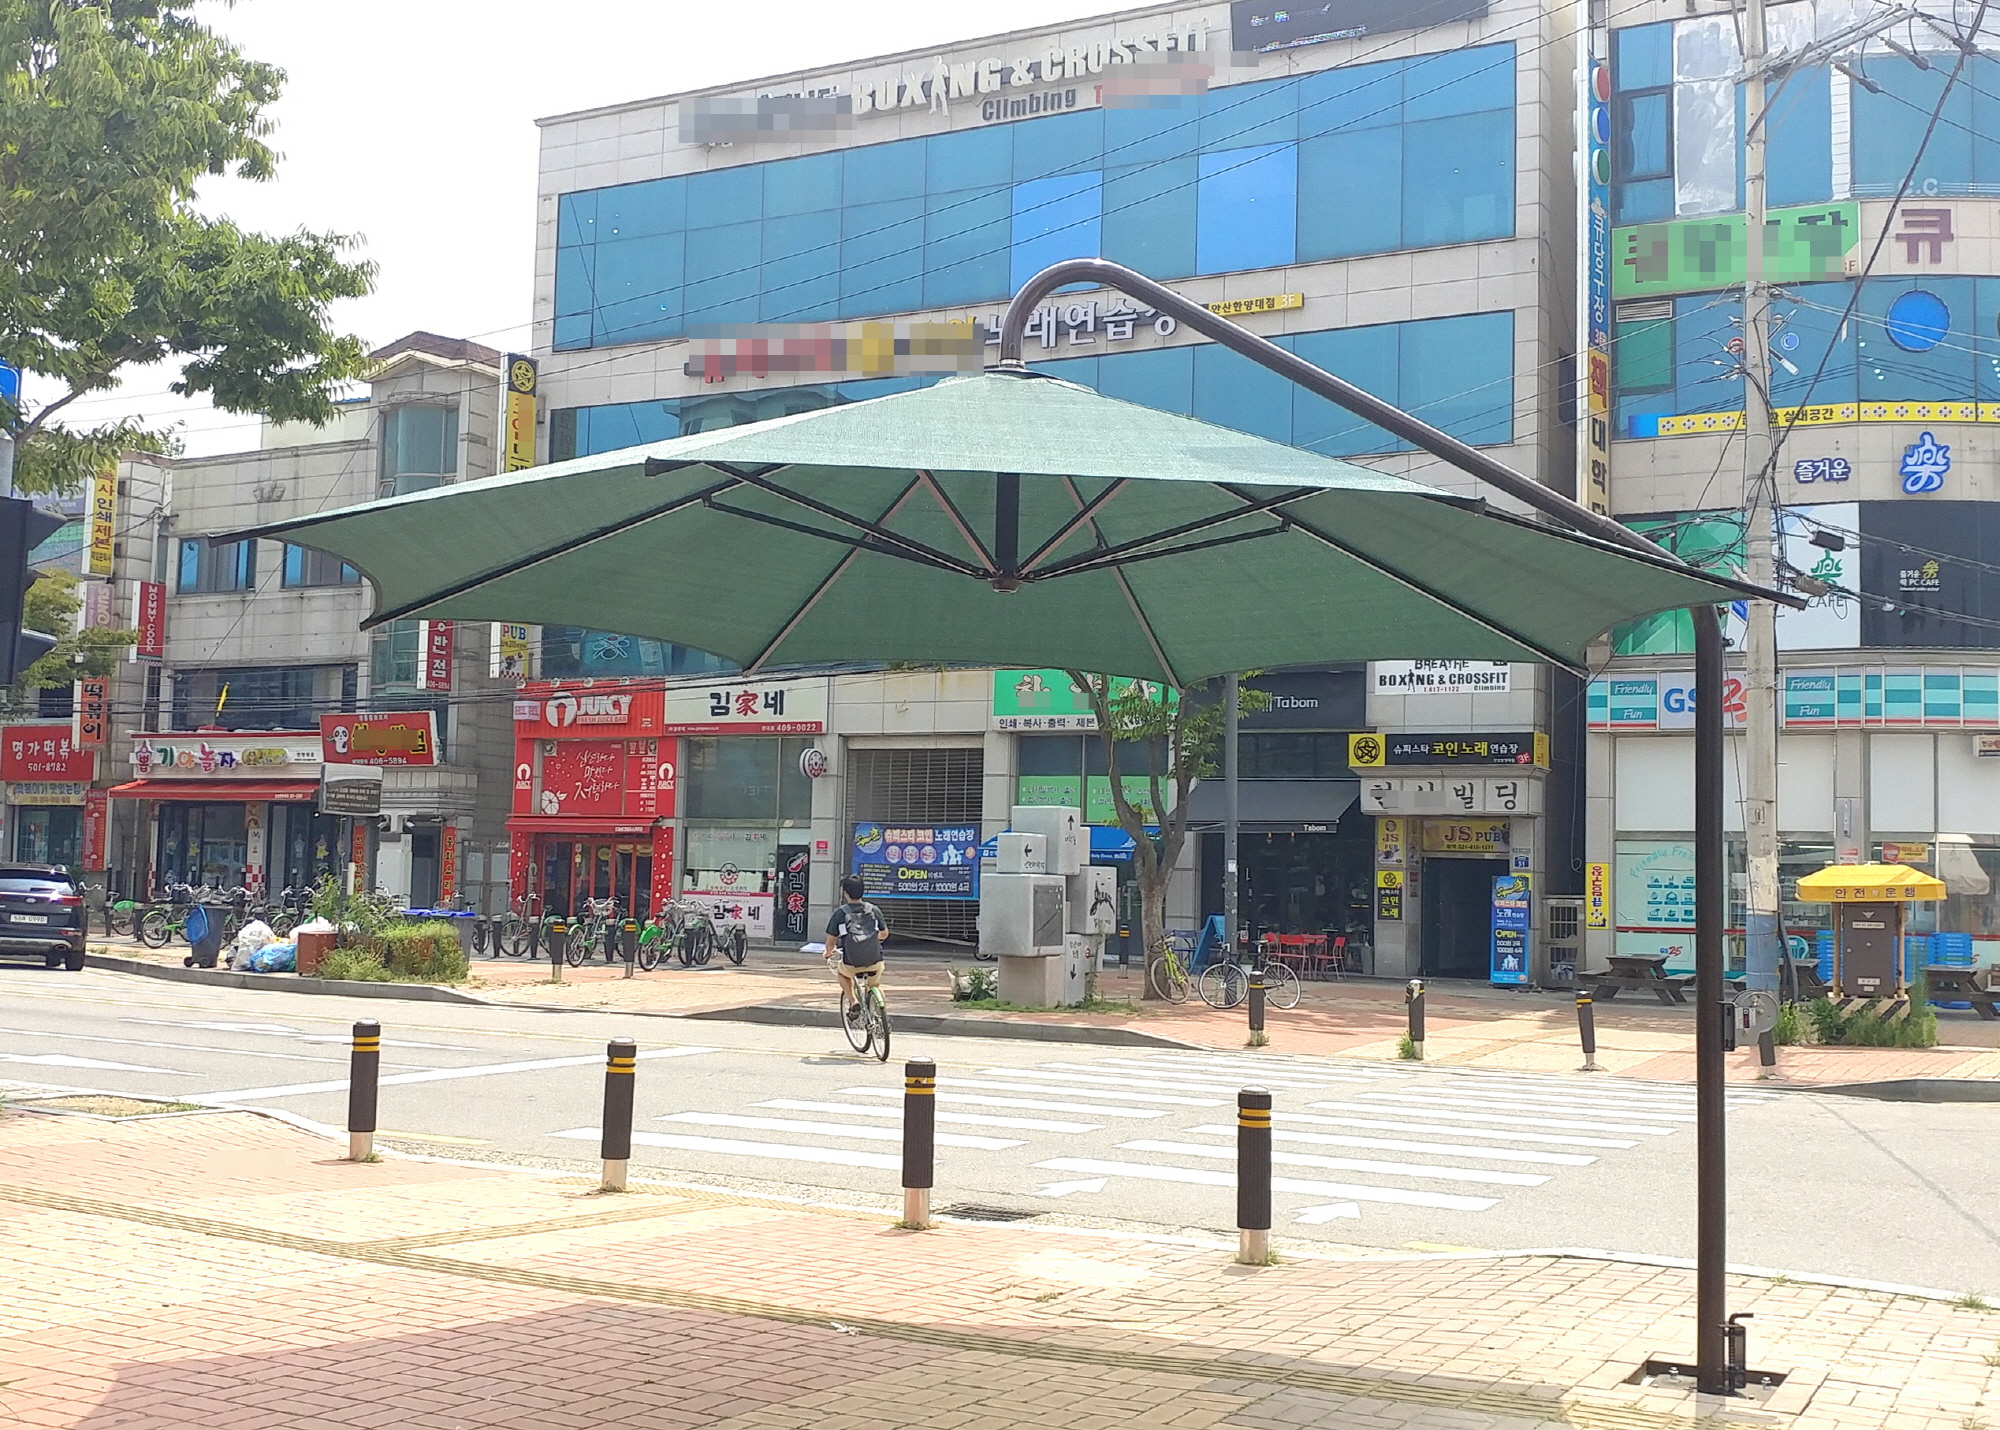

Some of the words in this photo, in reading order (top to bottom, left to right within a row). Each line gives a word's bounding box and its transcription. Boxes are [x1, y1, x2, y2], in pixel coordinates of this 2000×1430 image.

[1010, 56, 1036, 88] &
[981, 89, 1076, 121] Climbing
[1895, 208, 1954, 264] 큐
[1210, 297, 1275, 316] 안산한양대점
[1281, 293, 1296, 308] 3F
[1796, 458, 1850, 482] 즐거운
[1900, 569, 1921, 579] 즐거운
[502, 624, 527, 640] PUB
[1438, 674, 1446, 685] &
[1449, 672, 1508, 685] CROSSFIT
[1614, 682, 1653, 695] Friendly
[1790, 679, 1832, 691] Friendly
[577, 695, 634, 715] JUICY
[709, 690, 785, 717] 김家네
[1274, 696, 1319, 708] Tabom
[1623, 708, 1643, 719] Fun
[1800, 706, 1820, 717] Fun
[776, 724, 817, 732] 409-0022
[1075, 717, 1096, 728] 제본
[1432, 742, 1459, 757] 코인
[1460, 742, 1488, 757] 노래
[1490, 743, 1519, 754] 연습장
[369, 757, 408, 765] 406-5894
[28, 763, 67, 772] 501-8782
[1303, 824, 1327, 832] Tabom
[1444, 825, 1473, 843] JS
[1475, 832, 1501, 842] PUB
[934, 828, 975, 842] 노래연습장
[1382, 834, 1399, 843] JS
[898, 867, 928, 880] OPEN
[1835, 888, 1866, 899] 안전
[787, 871, 806, 933] 김家네
[1381, 896, 1399, 906] 코인
[1381, 908, 1399, 918] 노래
[1495, 930, 1517, 938] OPEN
[1659, 946, 1683, 957] GS25
